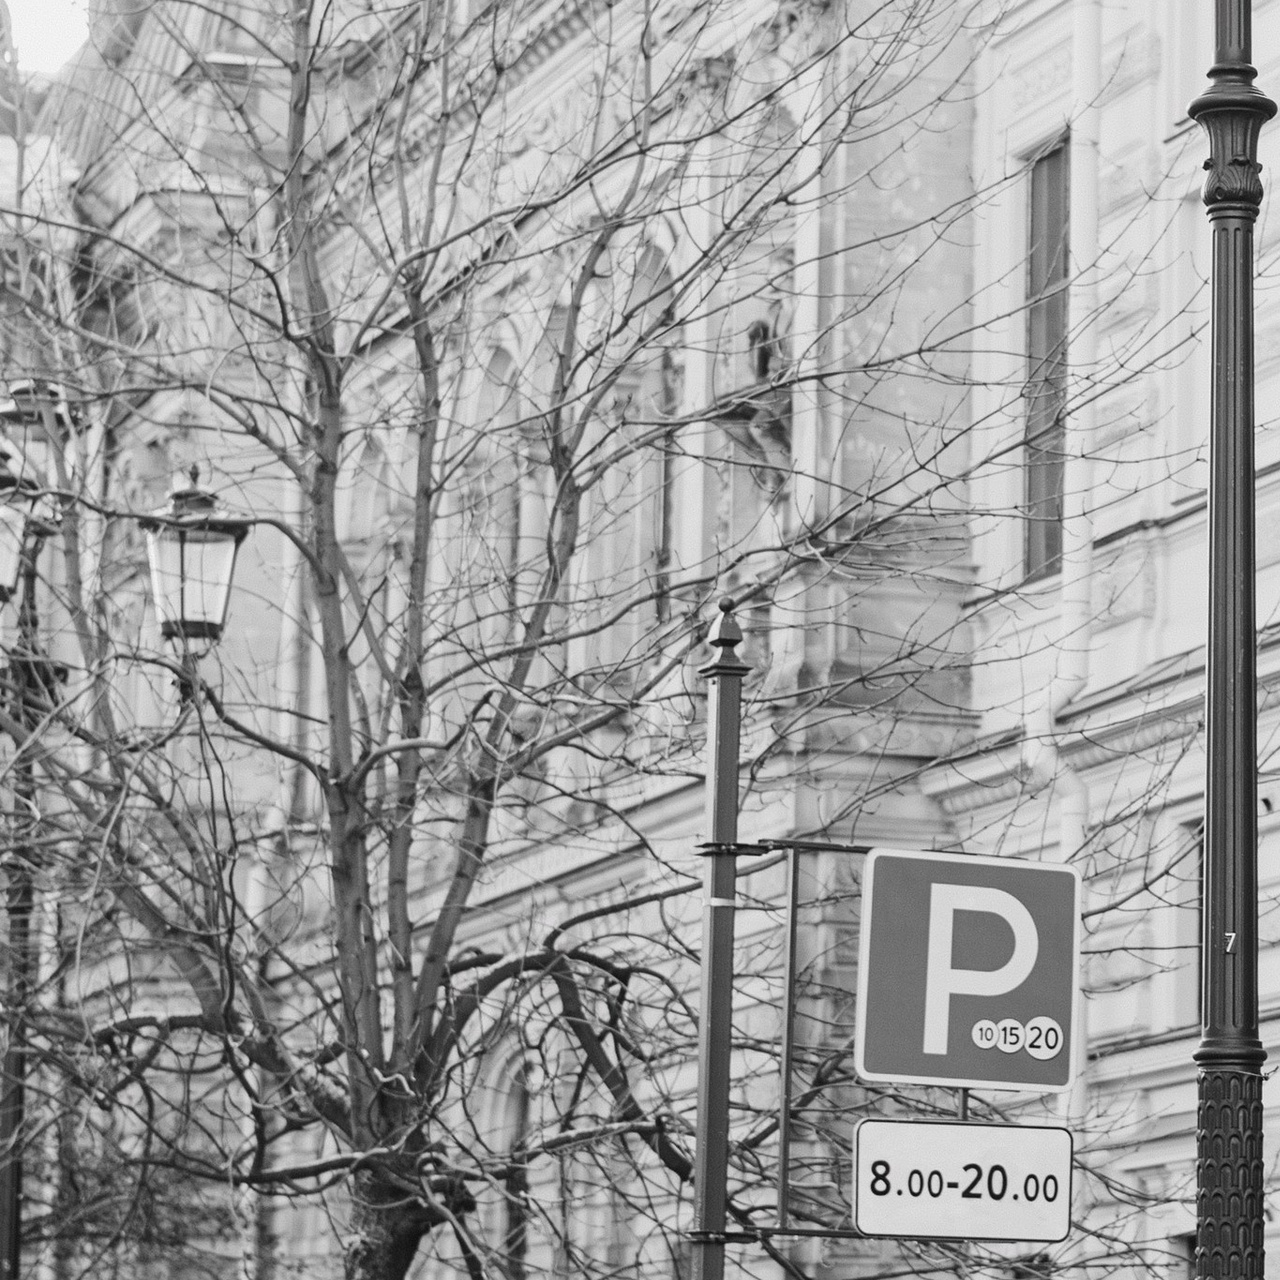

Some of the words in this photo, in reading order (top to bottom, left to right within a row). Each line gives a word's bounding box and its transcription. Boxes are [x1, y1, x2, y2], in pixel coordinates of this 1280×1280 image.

[1224, 932, 1236, 953] 7
[923, 882, 1039, 1055] P
[978, 1027, 994, 1042] 10
[1001, 1026, 1020, 1045] 15
[1028, 1026, 1059, 1050] 20
[870, 1160, 1059, 1202] 8.00-20.00
